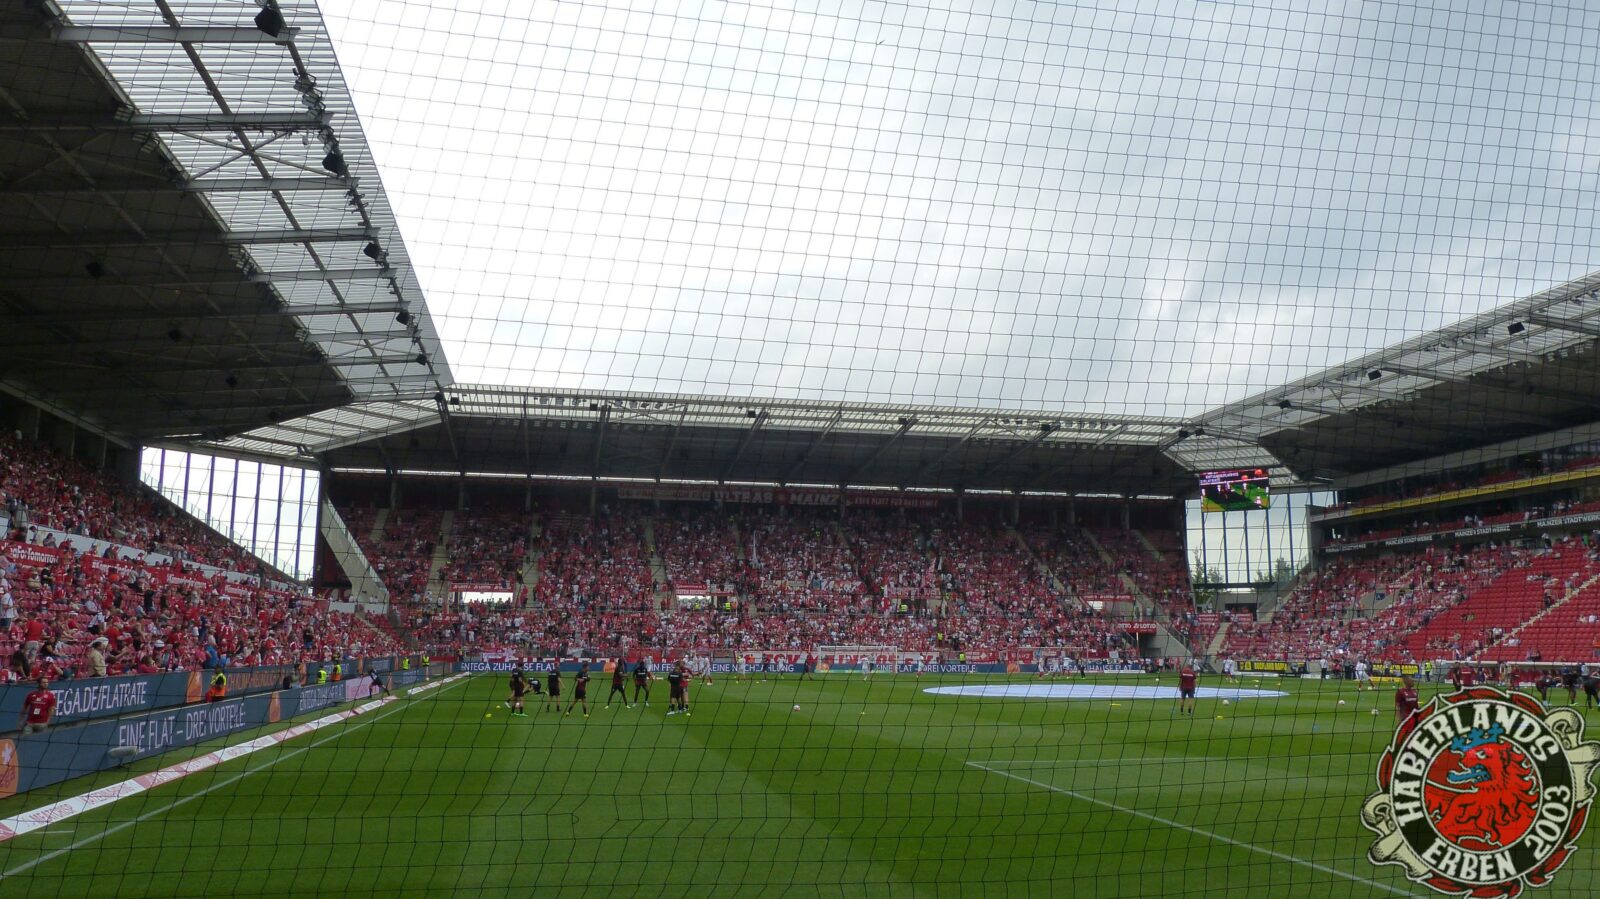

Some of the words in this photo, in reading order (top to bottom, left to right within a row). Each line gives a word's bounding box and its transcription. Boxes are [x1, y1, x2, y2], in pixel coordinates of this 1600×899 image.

[493, 662, 534, 671] ZUHASE
[119, 721, 146, 753] EINE
[149, 715, 176, 750] FLAT
